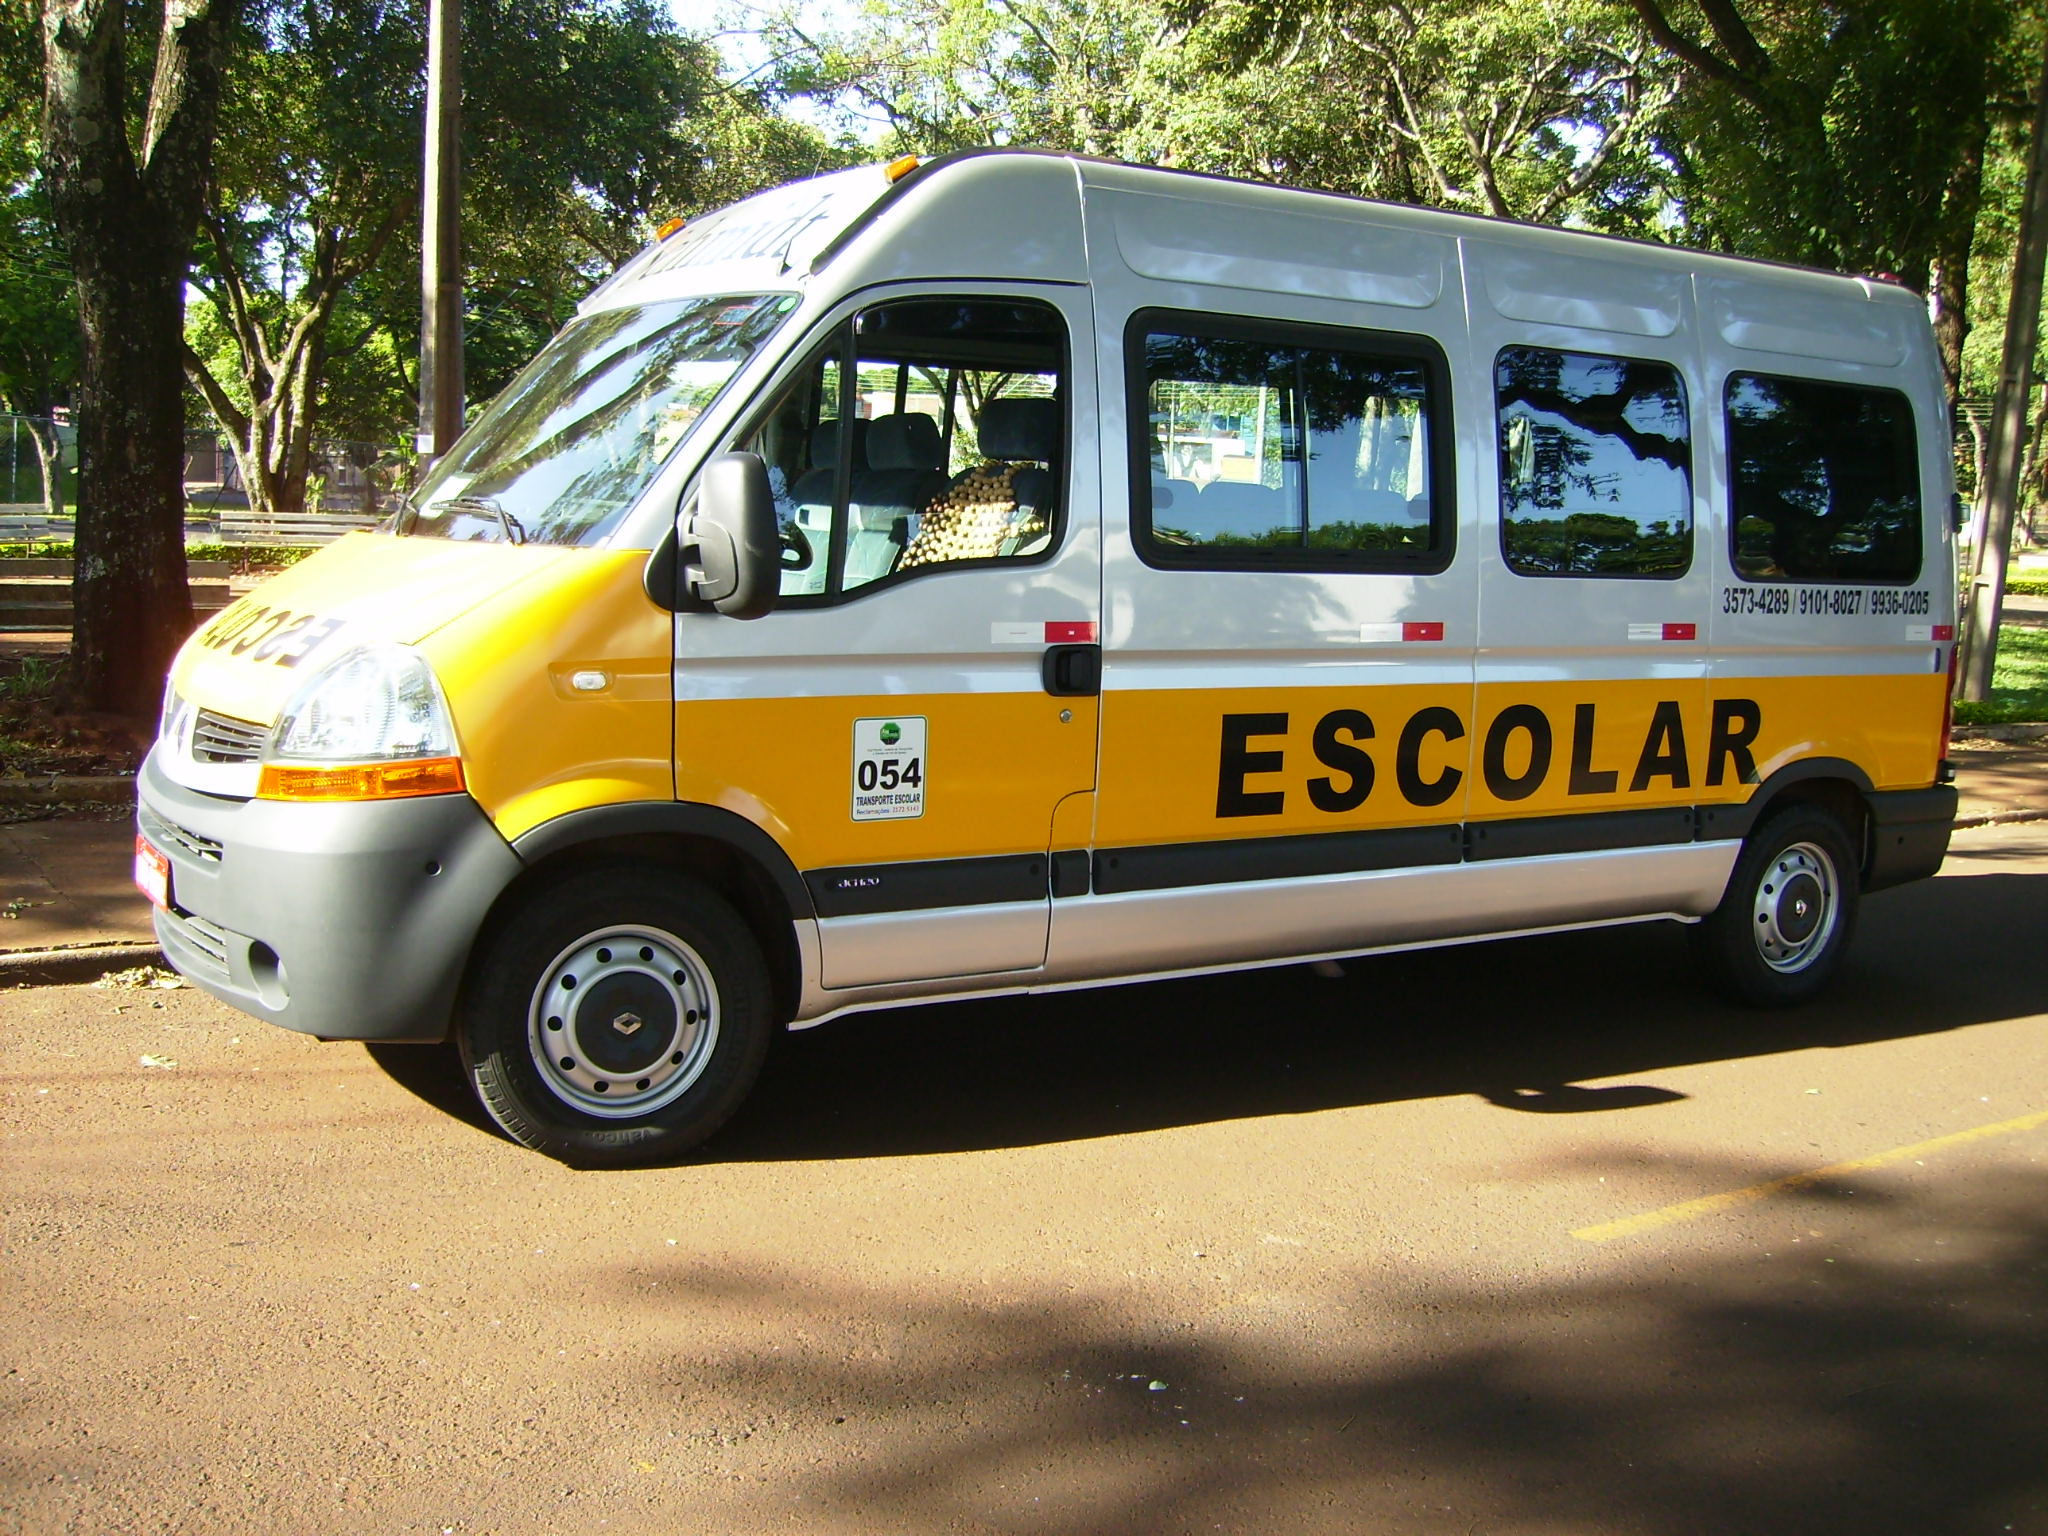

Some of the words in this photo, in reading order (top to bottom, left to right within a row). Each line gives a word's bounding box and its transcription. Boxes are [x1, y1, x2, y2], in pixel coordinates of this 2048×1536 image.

[1723, 587, 1789, 614] 3573-4289
[1800, 589, 1862, 615] 9101-8027
[1872, 590, 1929, 615] 9936-0205
[1216, 698, 1762, 818] ESCOLAR
[858, 757, 921, 791] 054
[856, 795, 894, 807] TRANSPORTE
[895, 793, 920, 804] ESCOLAR
